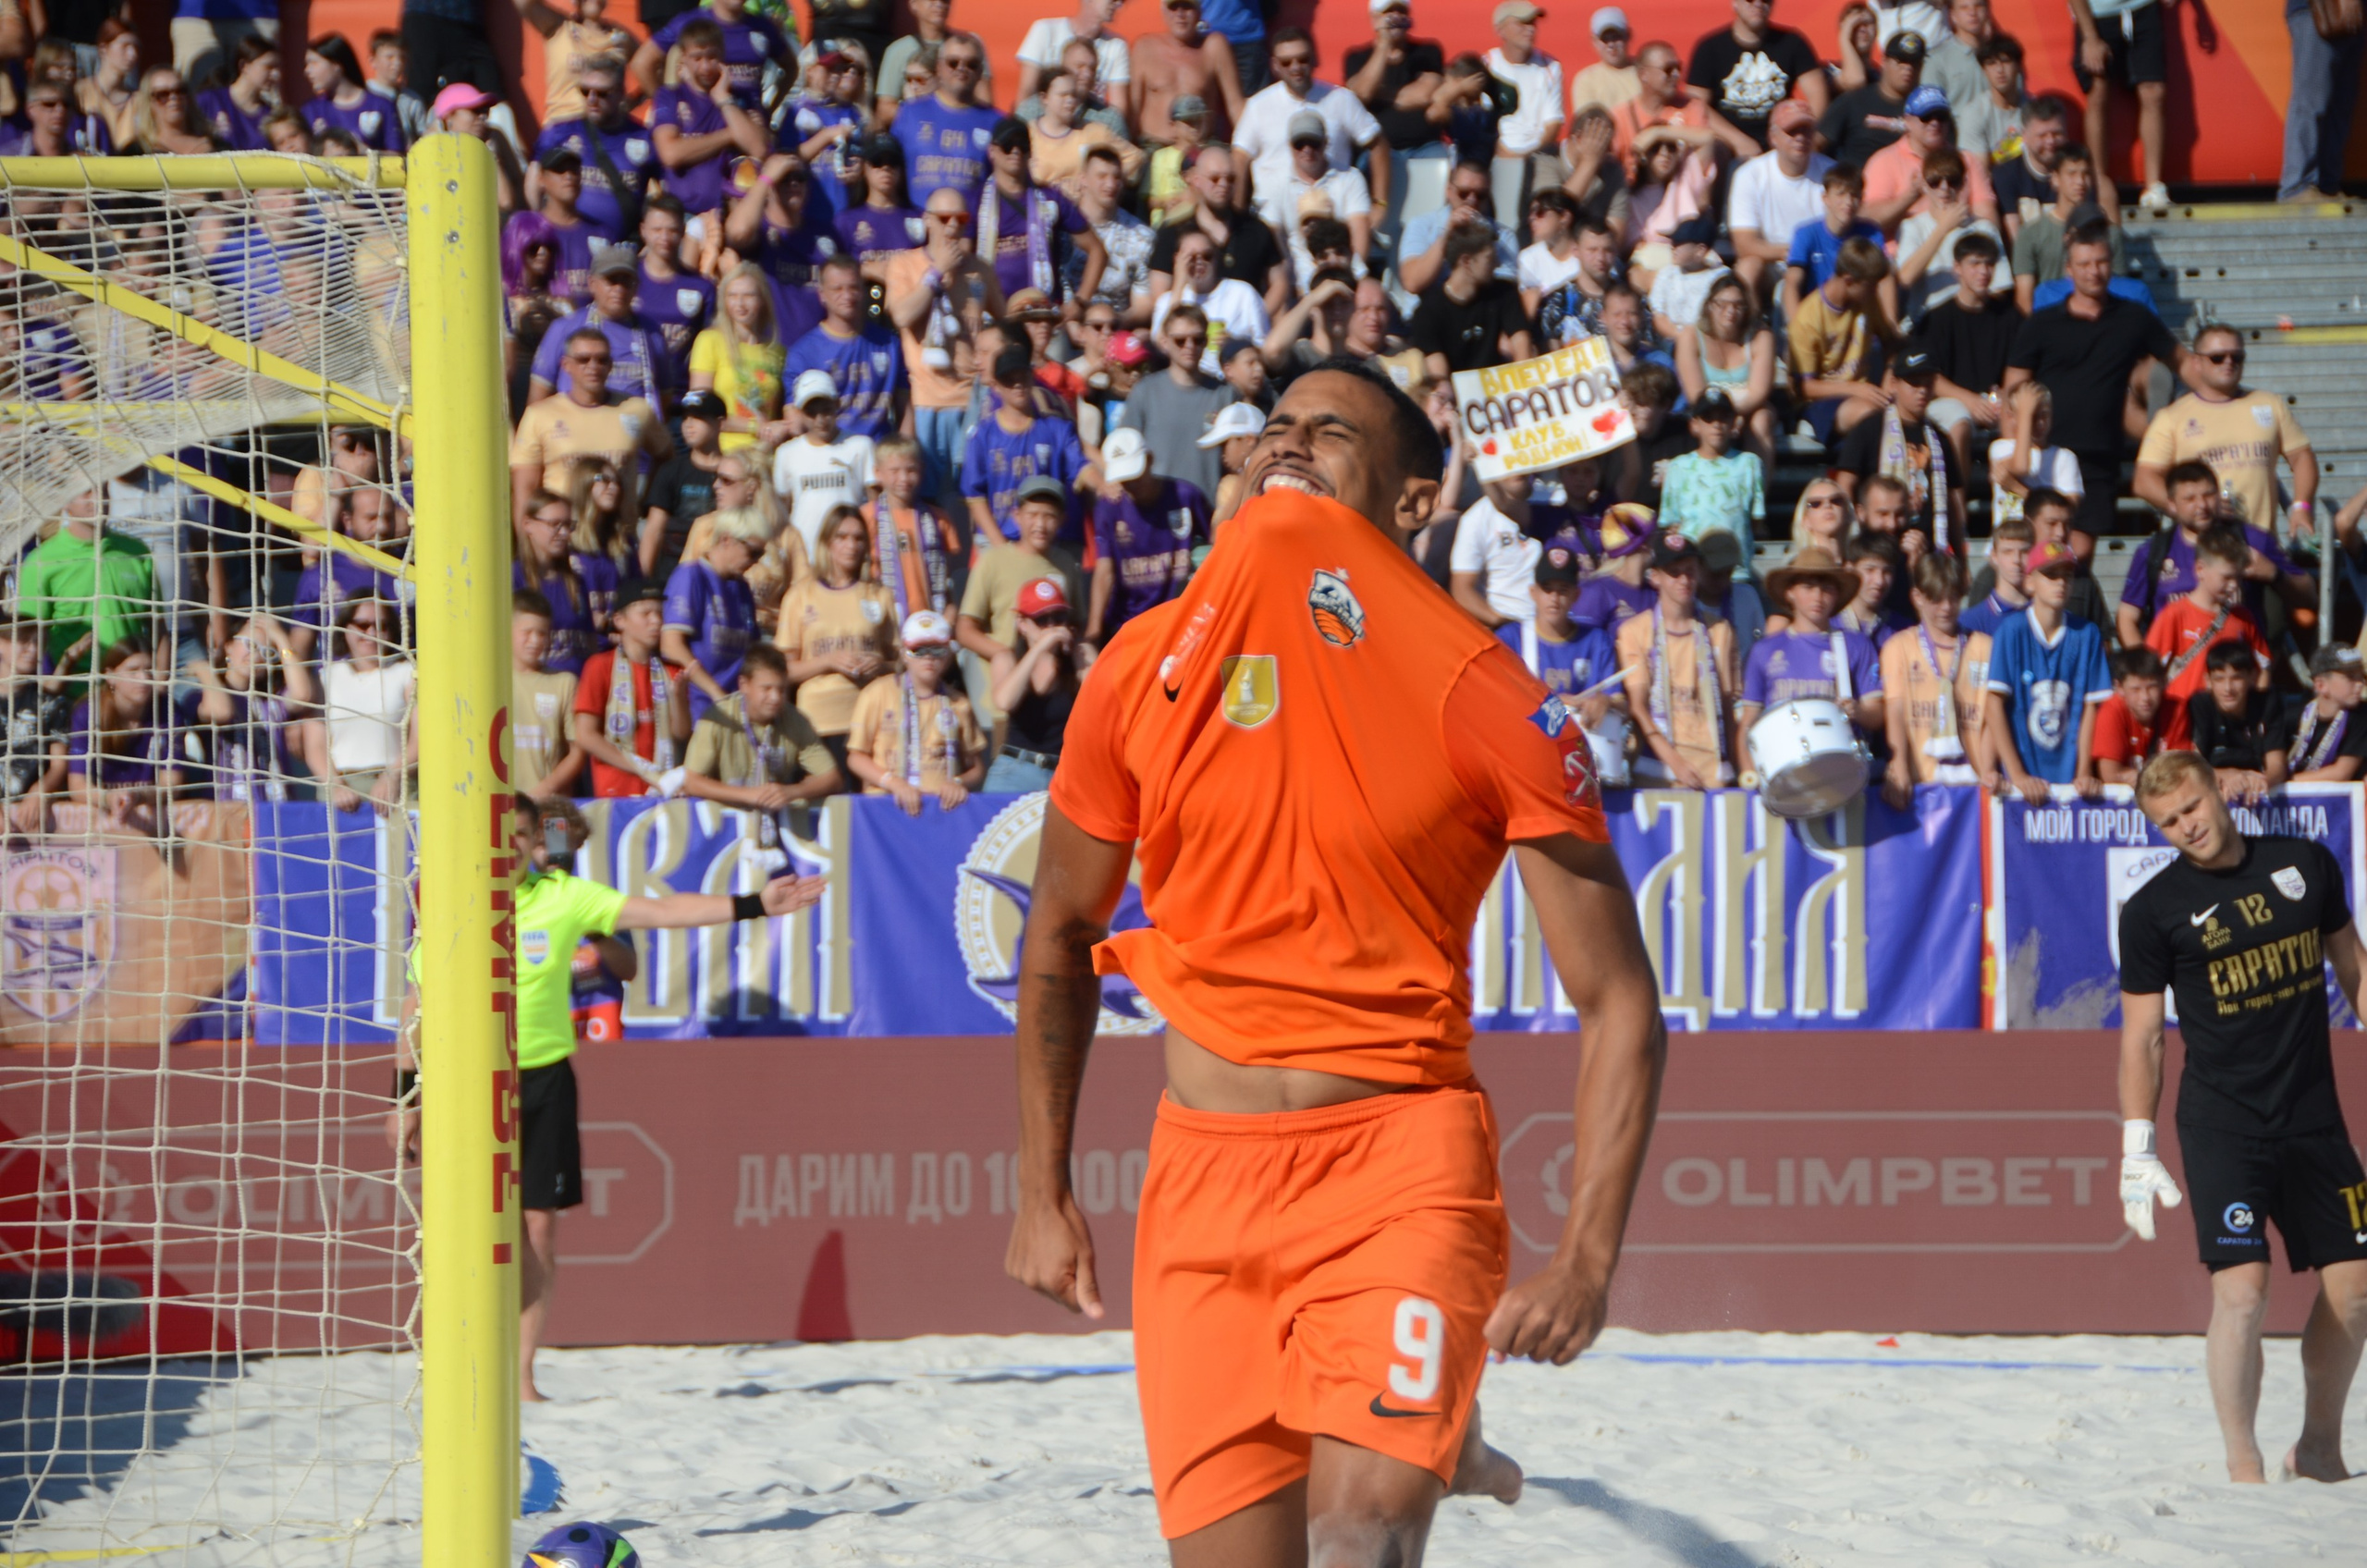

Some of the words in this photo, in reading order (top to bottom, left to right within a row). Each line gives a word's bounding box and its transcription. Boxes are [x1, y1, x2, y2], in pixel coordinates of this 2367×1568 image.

[1466, 366, 1621, 435] САРАТОВ
[1509, 420, 1566, 450] КЛУБ
[801, 471, 845, 492] PUMA
[2024, 804, 2073, 843] МОЙ
[2079, 808, 2148, 845] ГОРОД
[2127, 850, 2177, 878] САРА
[2233, 893, 2274, 928] 12
[521, 931, 546, 940] FIFA
[2201, 926, 2231, 944] АГОРА
[2207, 936, 2232, 950] БАНК
[734, 1152, 894, 1227] ДАРИМ
[906, 1151, 972, 1224] ДО
[1662, 1156, 2108, 1207] OLIMPBET
[2216, 1236, 2251, 1246] САРАТОВ
[1389, 1296, 1444, 1401] 9
